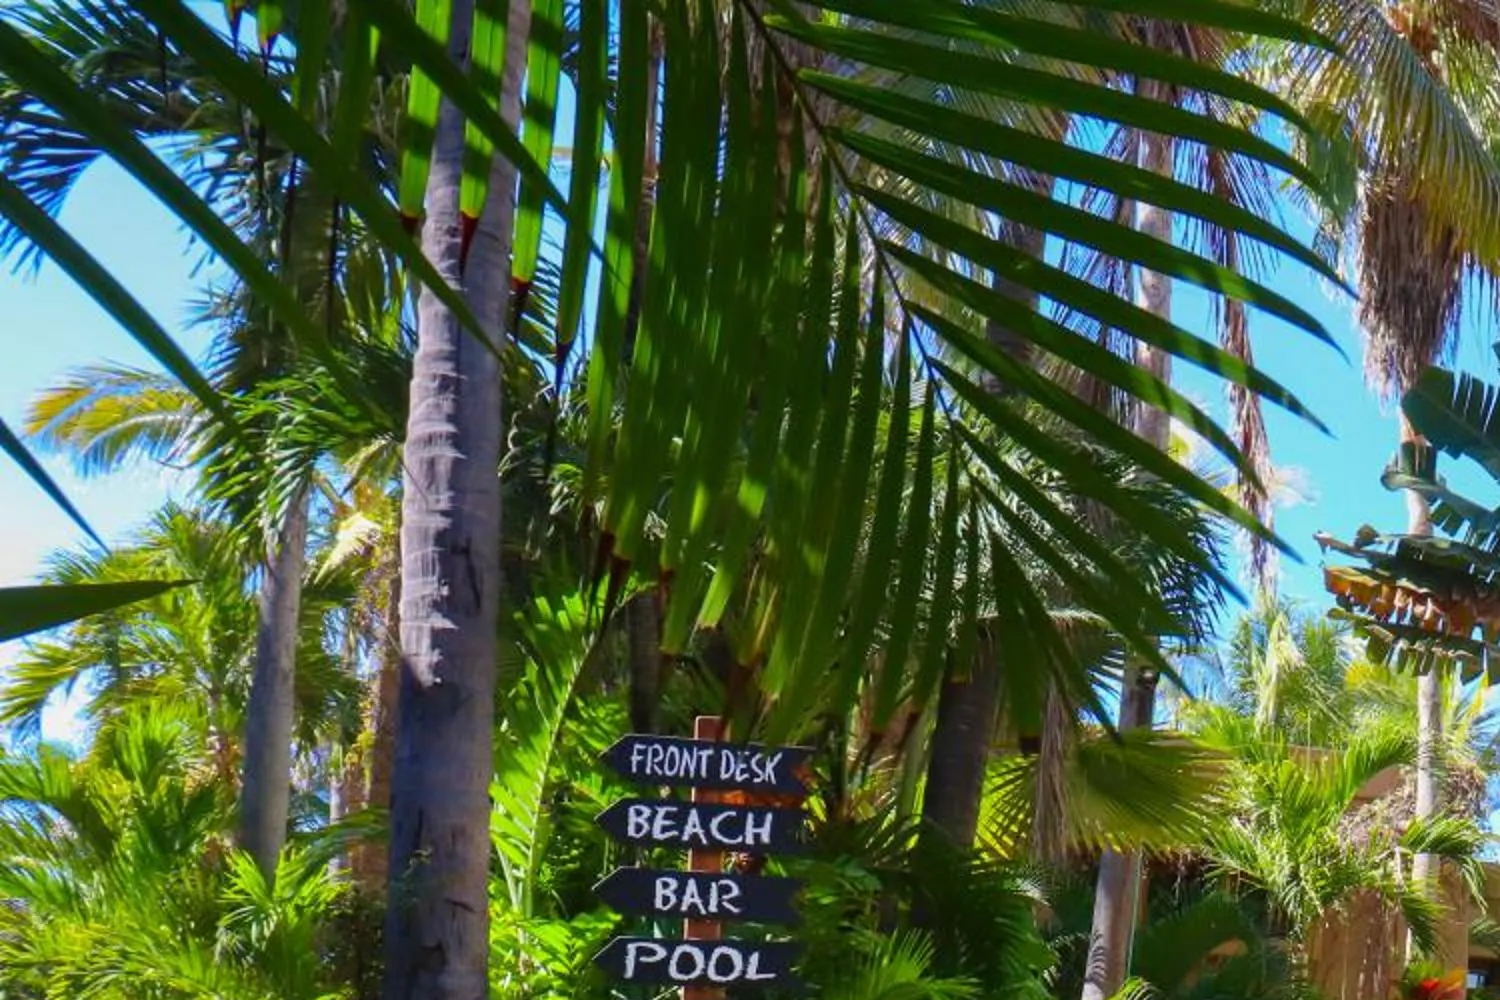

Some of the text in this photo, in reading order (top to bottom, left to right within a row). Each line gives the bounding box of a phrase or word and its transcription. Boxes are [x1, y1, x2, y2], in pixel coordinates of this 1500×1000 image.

[630, 744, 783, 784] FRONT DESK
[627, 805, 773, 845] BEACH
[654, 877, 743, 915] BAR
[623, 942, 777, 981] POOL
